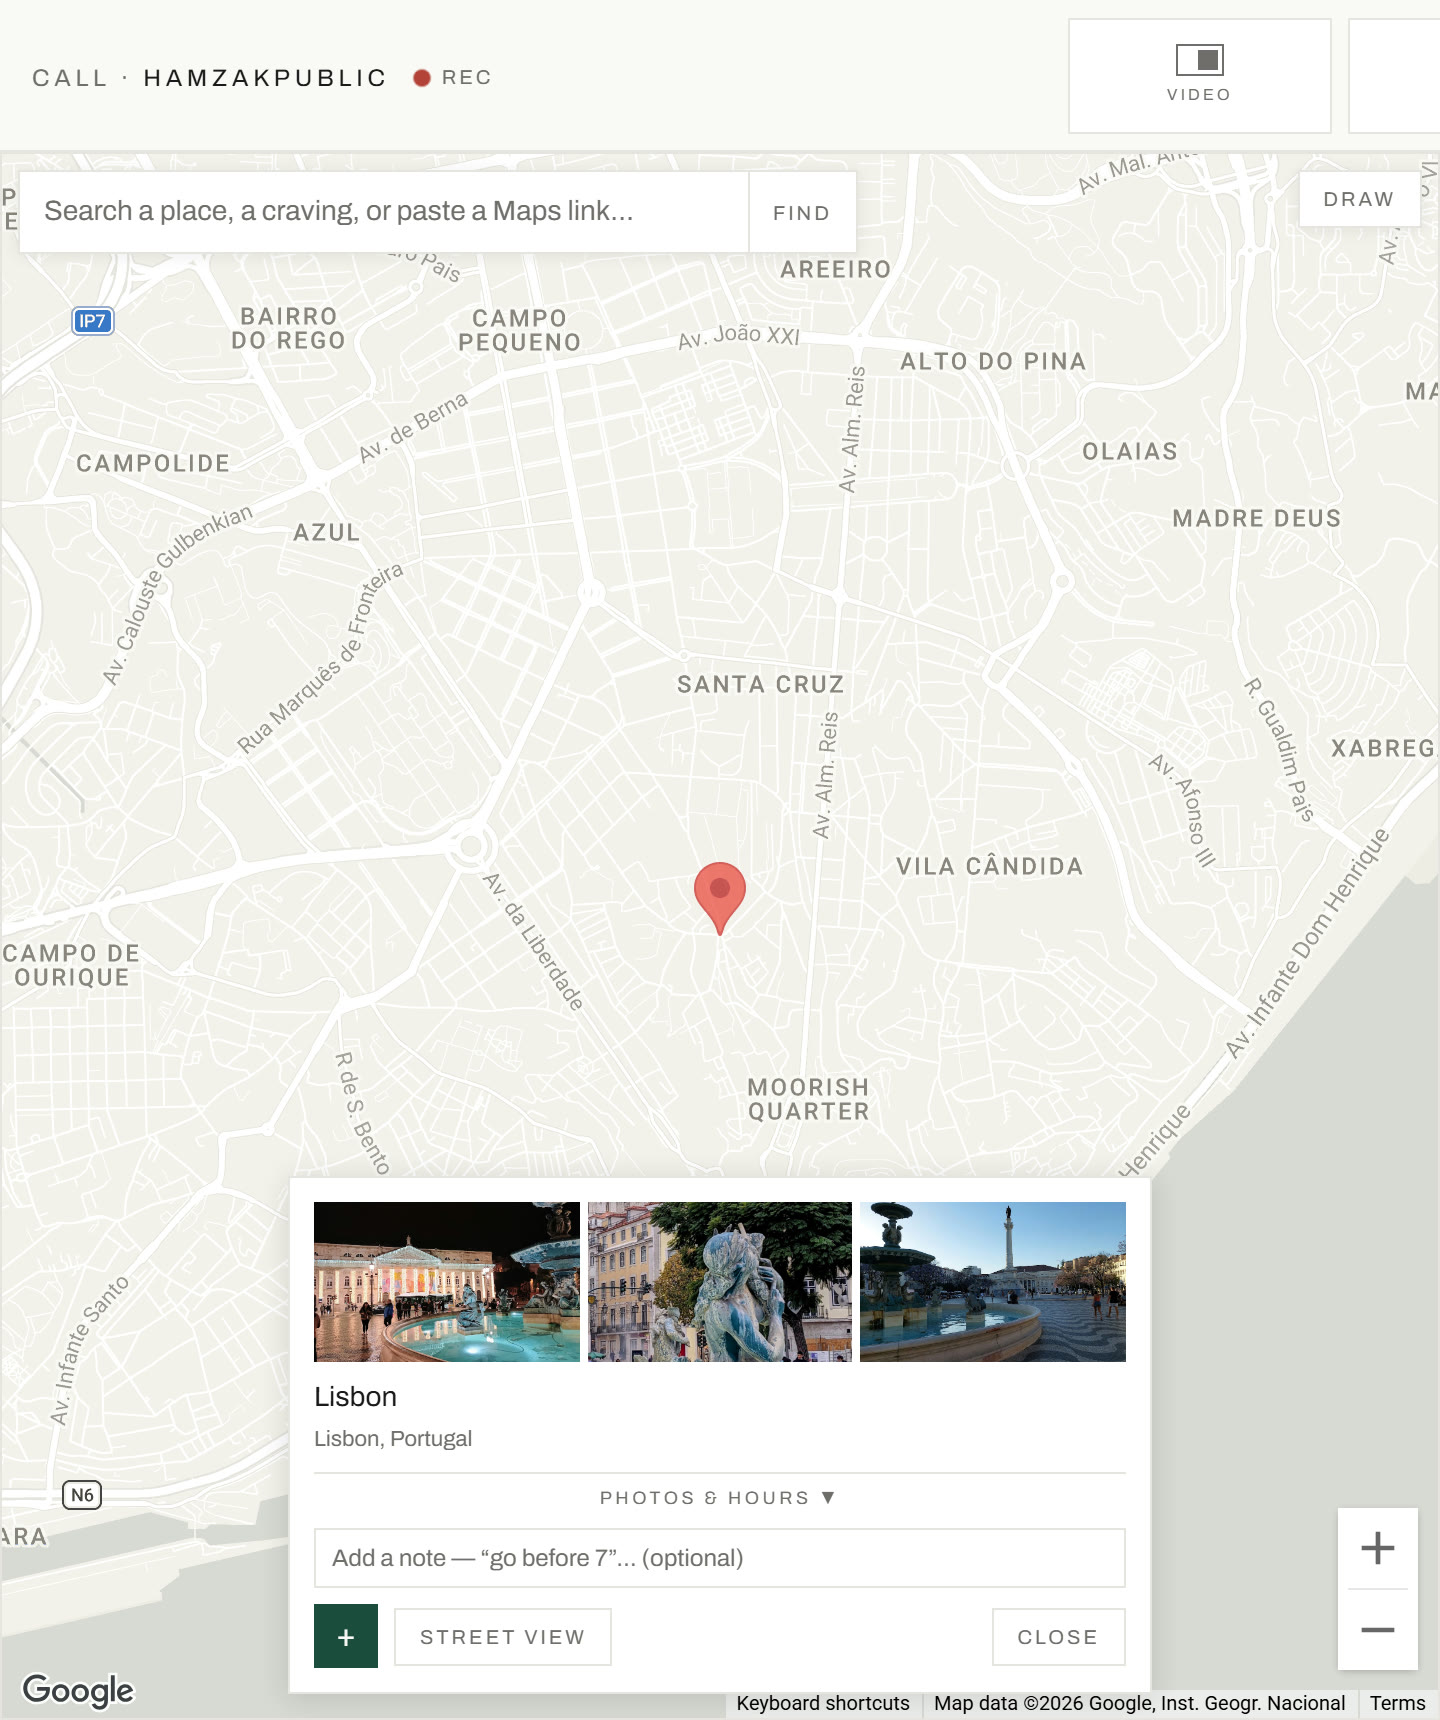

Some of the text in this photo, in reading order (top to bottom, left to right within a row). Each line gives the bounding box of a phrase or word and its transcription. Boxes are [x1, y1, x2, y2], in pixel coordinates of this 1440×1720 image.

[32, 68, 385, 87] CALL HAMZAKPUBLIC
[442, 69, 491, 85] REC
[1166, 88, 1230, 101] VIDEO
[1079, 173, 1108, 195] Av.
[1109, 154, 1151, 178] Mal.
[1324, 191, 1394, 207] DRAW
[44, 199, 132, 222] Search
[138, 204, 155, 222] a
[161, 199, 233, 226] place,
[241, 204, 257, 222] a
[262, 199, 359, 226] craving,
[366, 204, 392, 222] or
[397, 200, 466, 226] paste
[471, 204, 488, 222] a
[494, 200, 562, 226] Maps
[773, 205, 829, 221] FIND
[1378, 235, 1399, 266] Av.
[420, 254, 461, 283] Pais
[780, 259, 890, 279] AREEIRO
[80, 314, 106, 328] IP7
[241, 306, 336, 326] BAIRRO
[472, 308, 566, 328] CAMPO
[232, 330, 345, 350] DO REGO
[459, 332, 580, 354] PEQUENO
[678, 323, 800, 351] Av. João XXI
[900, 351, 1086, 371] ALTO DO PINA
[360, 393, 469, 465] Av. de Berna
[838, 366, 866, 494] Av. Alm. Reis
[1082, 441, 1177, 461] OLAIAS
[76, 453, 229, 473] CAMPOLIDE
[1173, 508, 1340, 528] MADRE DEUS
[293, 522, 360, 542] AZUL
[102, 506, 254, 687] Av. Calouste Gulbenkian
[236, 564, 404, 755] Rua Marquês de Fronteira
[677, 674, 844, 694] SANTA CRUZ
[1243, 677, 1314, 823] R. Gualdim Pais
[1331, 738, 1438, 758] XABREG
[812, 711, 839, 840] Av. Alm. Reis
[1147, 753, 1217, 868] Av. Afonso III
[896, 852, 1083, 876] VILA CÂNDIDA
[2, 943, 139, 963] CAMPO DE
[481, 873, 583, 1012] Av. da Liberdade
[1226, 828, 1390, 1060] Av. Infante Dom Henrique
[14, 967, 129, 989] OURIQUE
[748, 1077, 868, 1097] MOORISH
[335, 1051, 390, 1176] R de S. Bento
[748, 1101, 869, 1123] QUARTER
[50, 1276, 129, 1427] Av. Infante Santo
[315, 1385, 397, 1408] Lisbon
[315, 1429, 472, 1451] Lisbon, Portugal
[71, 1487, 94, 1503] N6
[600, 1490, 808, 1505] PHOTOS & HOURS
[331, 1547, 375, 1567] Add
[380, 1552, 395, 1567] a
[399, 1549, 446, 1567] note
[522, 1547, 590, 1567] before
[642, 1547, 744, 1571] (optional)
[420, 1629, 585, 1645] STREET VIEW
[1017, 1629, 1097, 1645] CLOSE
[22, 1673, 134, 1711] Google
[737, 1694, 910, 1715] Keyboard shortcuts
[935, 1694, 1345, 1715] Map data ©2026 Google, Inst. Geogr. Nacional
[1369, 1695, 1426, 1711] Terms
